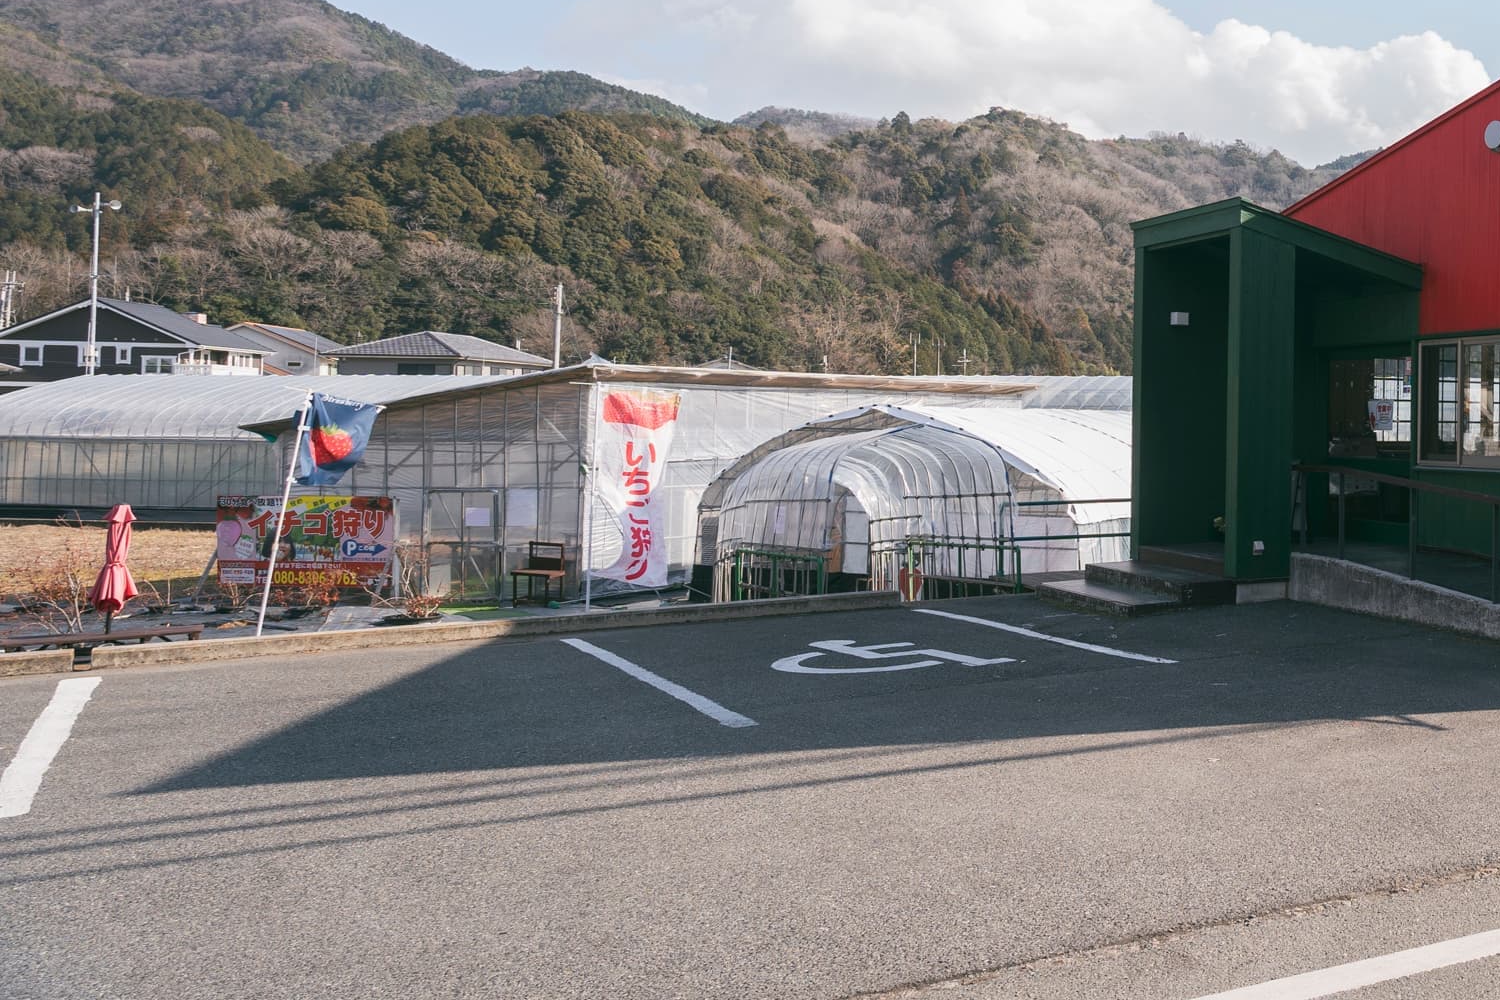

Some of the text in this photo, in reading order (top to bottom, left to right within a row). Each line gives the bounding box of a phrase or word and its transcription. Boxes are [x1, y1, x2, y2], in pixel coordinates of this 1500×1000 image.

[247, 509, 385, 539] イチゴ狩り
